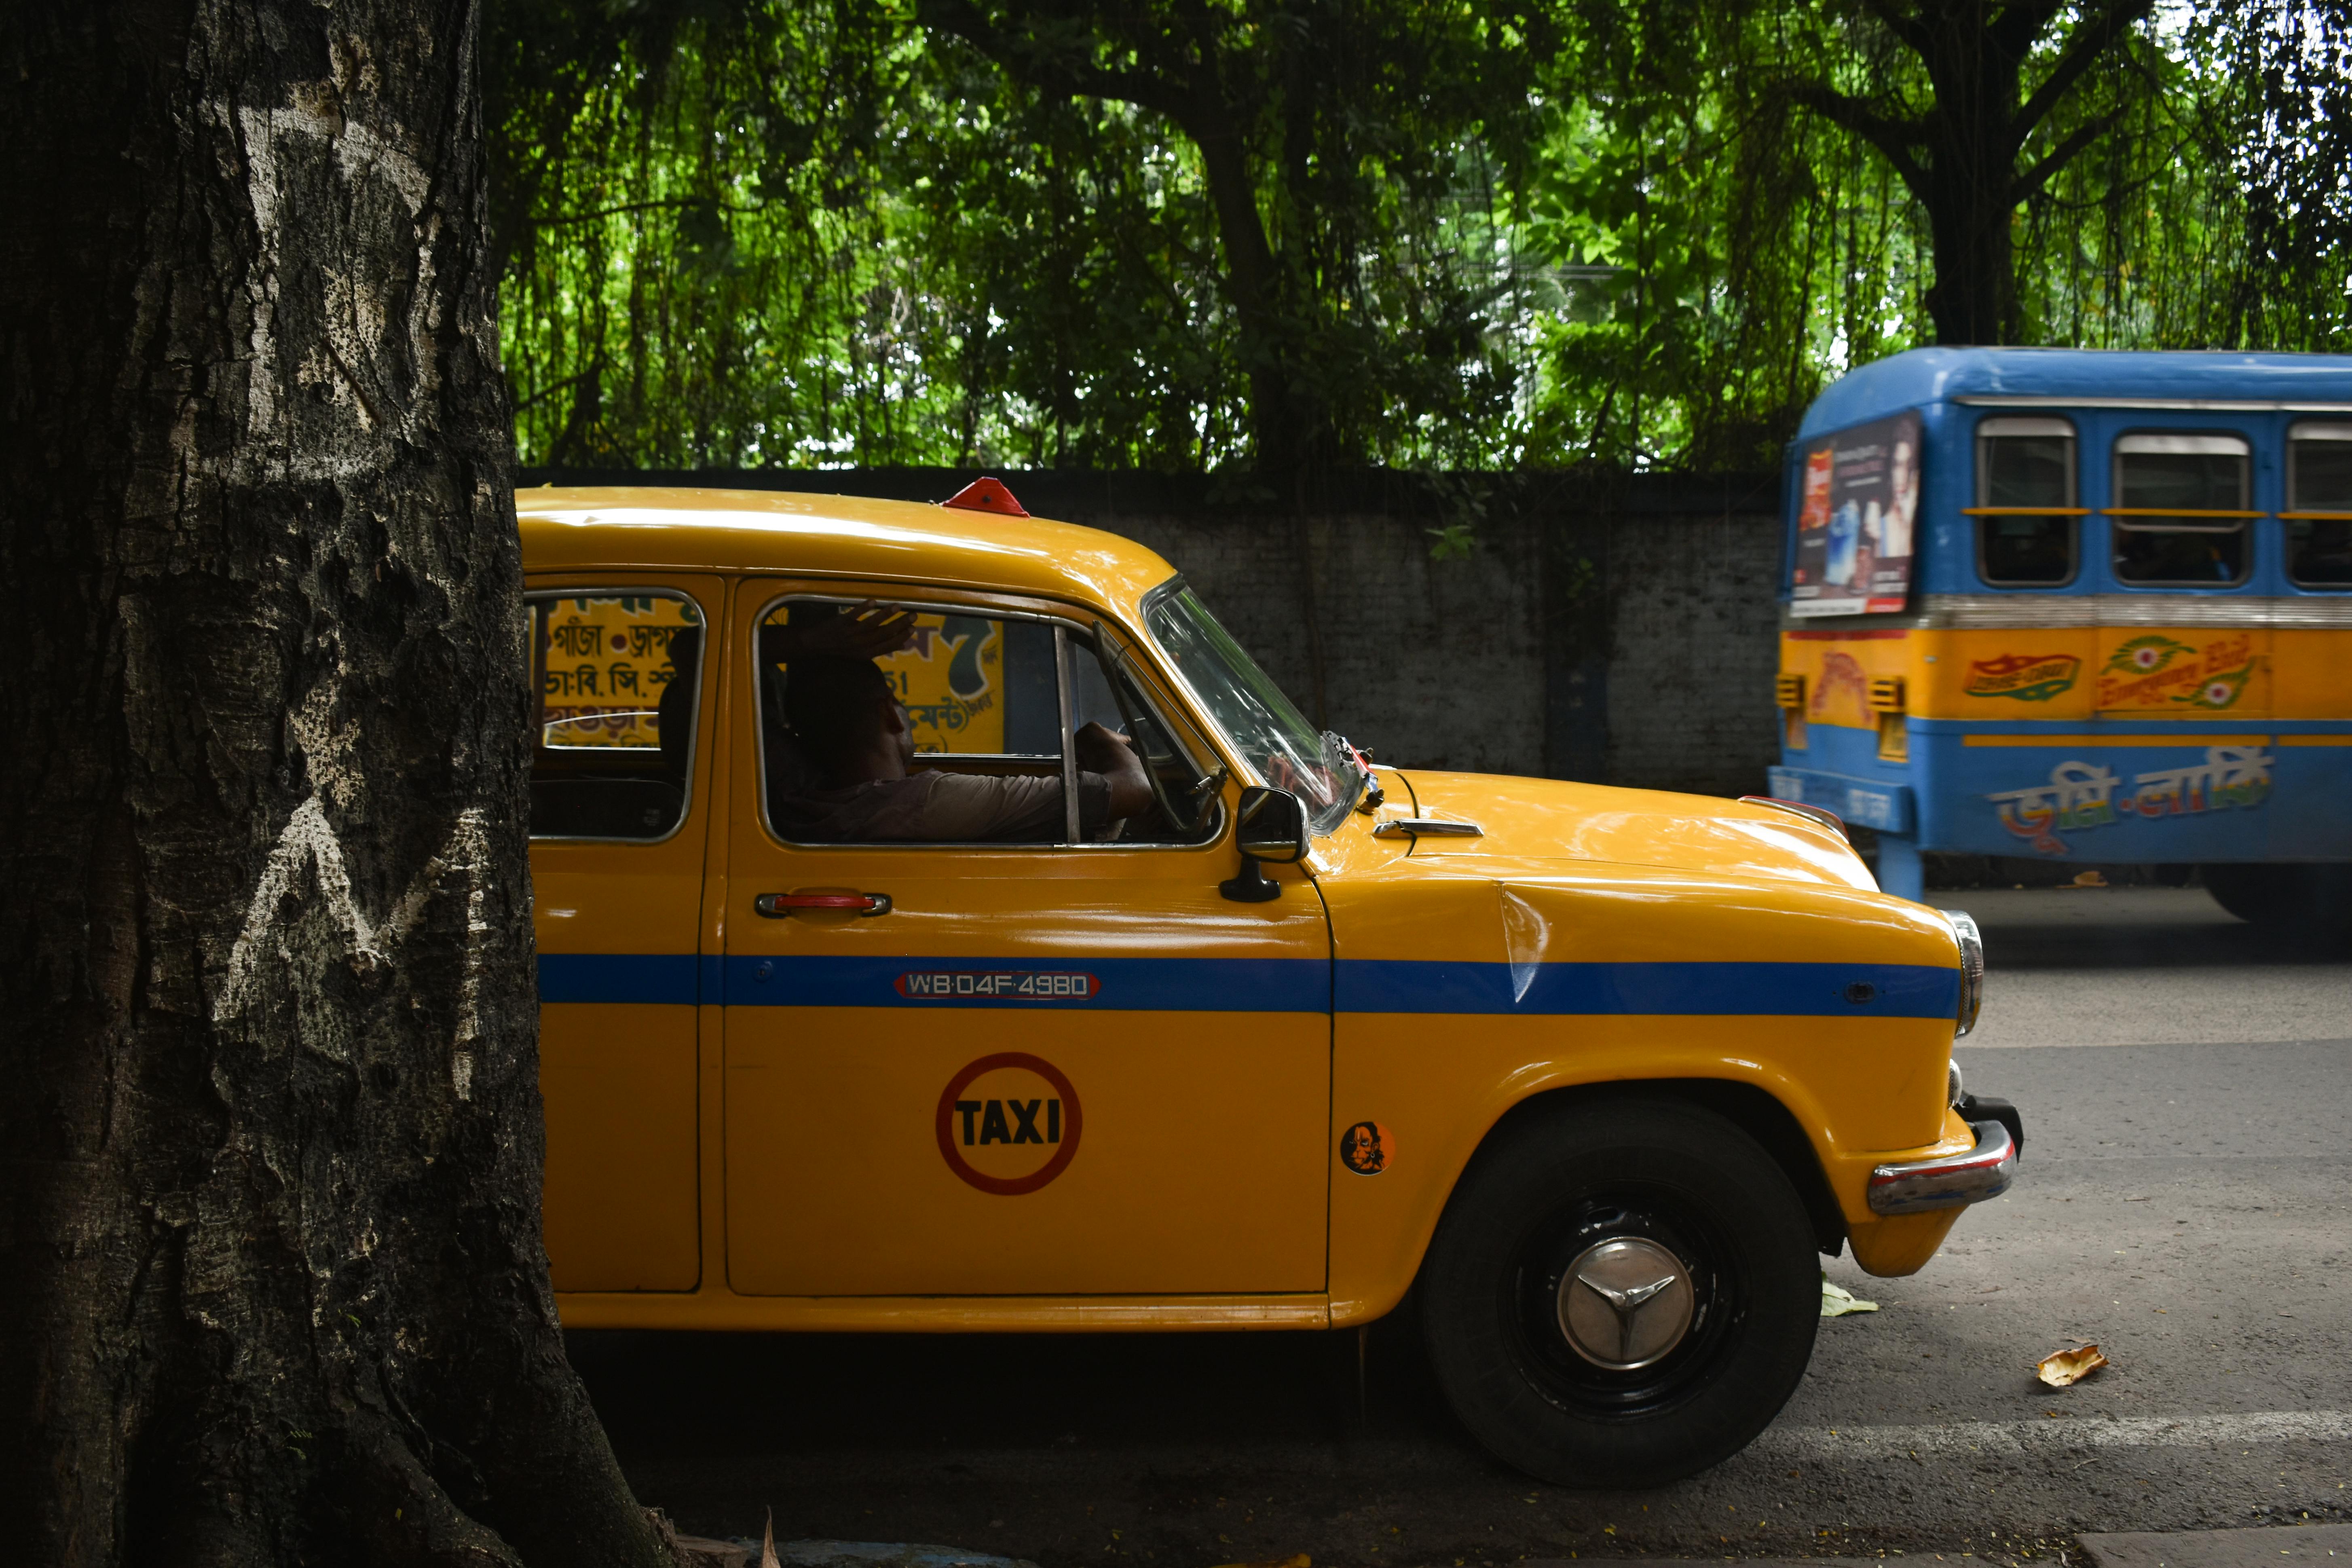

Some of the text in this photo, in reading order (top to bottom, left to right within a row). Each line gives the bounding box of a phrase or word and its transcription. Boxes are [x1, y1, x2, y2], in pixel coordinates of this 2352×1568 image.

[554, 616, 683, 658] গাঁজা ড্রাগ
[955, 1099, 1060, 1146] TAXI
